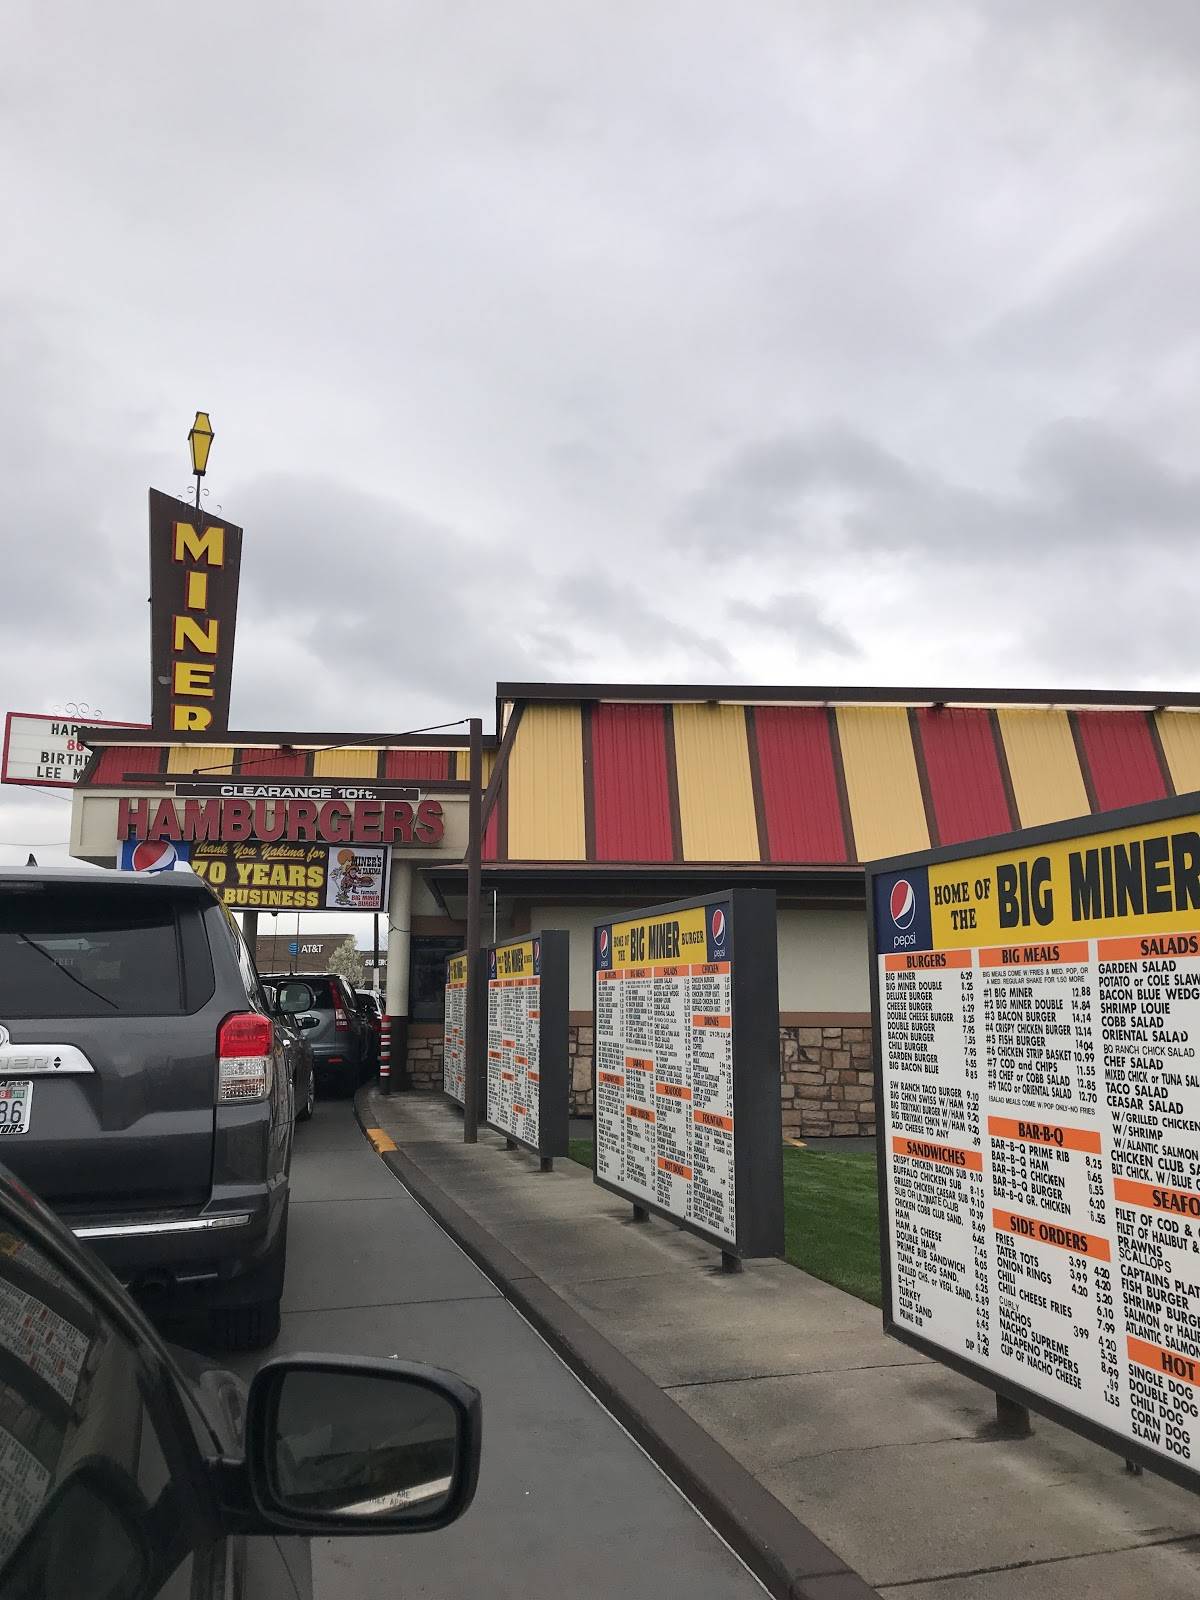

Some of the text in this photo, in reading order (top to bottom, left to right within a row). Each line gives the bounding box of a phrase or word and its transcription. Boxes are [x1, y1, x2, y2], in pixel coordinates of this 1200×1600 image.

[172, 521, 225, 731] MINER
[36, 766, 62, 779] LEE
[220, 785, 377, 800] CLEARANCE 10ft.
[116, 798, 444, 844] HAMBURGERS
[196, 842, 326, 862] Thank You Yakima for
[191, 861, 324, 889] 70 YEARS
[996, 831, 1200, 929] BIG MINER
[222, 888, 319, 909] BUSINESS
[933, 877, 991, 906] HOME OF
[950, 907, 977, 931] THE
[301, 944, 324, 953] AT&T
[630, 921, 680, 962] BIG MINER
[681, 930, 705, 946] BURGER
[893, 932, 916, 948] pepsi
[1140, 935, 1199, 956] SALADS
[906, 953, 947, 969] BURGERS
[1001, 945, 1060, 964] BIG MEALS
[885, 972, 895, 981] BIG
[897, 972, 916, 981] MINER
[1098, 960, 1177, 974] GARDEN SALAD
[1098, 973, 1200, 988] POTATO or COLE SLAW
[983, 988, 992, 998] #1
[994, 988, 1007, 998] BIG
[1009, 987, 1033, 998] MINER
[1099, 989, 1133, 1001] BACON
[1137, 988, 1161, 1001] BLUE
[984, 1000, 994, 1009] #2
[995, 999, 1007, 1009] BIG
[1009, 999, 1032, 1010] MINER
[1034, 999, 1063, 1010] DOUBLE
[1100, 1002, 1171, 1015] SHRIMP LOUIE
[887, 1021, 909, 1031] DOUBLE
[911, 1022, 936, 1032] BURGER
[984, 1011, 995, 1021] #3
[997, 1011, 1023, 1022] BACON
[1025, 1011, 1057, 1022] BURGER
[1101, 1015, 1164, 1028] COBB SALAD
[1102, 1028, 1189, 1043] ORIENTAL SALAD
[987, 1058, 997, 1068] #7
[1000, 1058, 1016, 1069] COD
[1018, 1060, 1033, 1071] and
[1035, 1061, 1058, 1073] CHIPS
[1103, 1055, 1164, 1071] CHEF SALAD
[890, 1080, 899, 1090] SW
[900, 1081, 920, 1093] RANCH
[921, 1084, 937, 1095] TACO
[938, 1086, 962, 1098] BURGER
[1105, 1081, 1168, 1099] TACO SALAD
[1106, 1095, 1184, 1115] CEASAR SALAD
[1112, 1123, 1163, 1141] W/SHRIMP
[906, 1141, 966, 1166] SANDWICHES
[991, 1138, 1026, 1155] BAR-B-Q
[1028, 1145, 1053, 1160] PRIME
[1056, 1149, 1070, 1163] RIB
[1110, 1149, 1184, 1173] CHICKEN CLUB
[896, 1219, 911, 1232] HAM
[920, 1227, 942, 1242] CHEESE
[1115, 1207, 1193, 1238] FILET OF COD &
[1010, 1215, 1089, 1253] SIDE ORDERS
[995, 1231, 1015, 1248] FRIES
[1068, 1255, 1087, 1270] 3.99
[1117, 1234, 1163, 1259] PRAWNS
[996, 1244, 1017, 1260] TATER
[1019, 1251, 1039, 1268] TOTS
[1069, 1268, 1088, 1284] 3.99
[997, 1256, 1024, 1276] ONION
[1026, 1267, 1052, 1285] RINGS
[1119, 1246, 1172, 1275] SCALLOPS
[1120, 1263, 1170, 1290] CAPTAINS
[898, 1285, 921, 1303] TURKEY
[1121, 1277, 1190, 1311] FISH BURGER
[999, 1305, 1033, 1329] NACHOS
[1161, 1351, 1196, 1382] HOT
[1128, 1363, 1194, 1401] SINGLE DOG
[1128, 1377, 1199, 1418] DOUBLE DOG
[1130, 1392, 1184, 1427] CHILI DOG
[1131, 1407, 1191, 1445] CORN DOG
[1132, 1421, 1191, 1460] SLAW DOG
